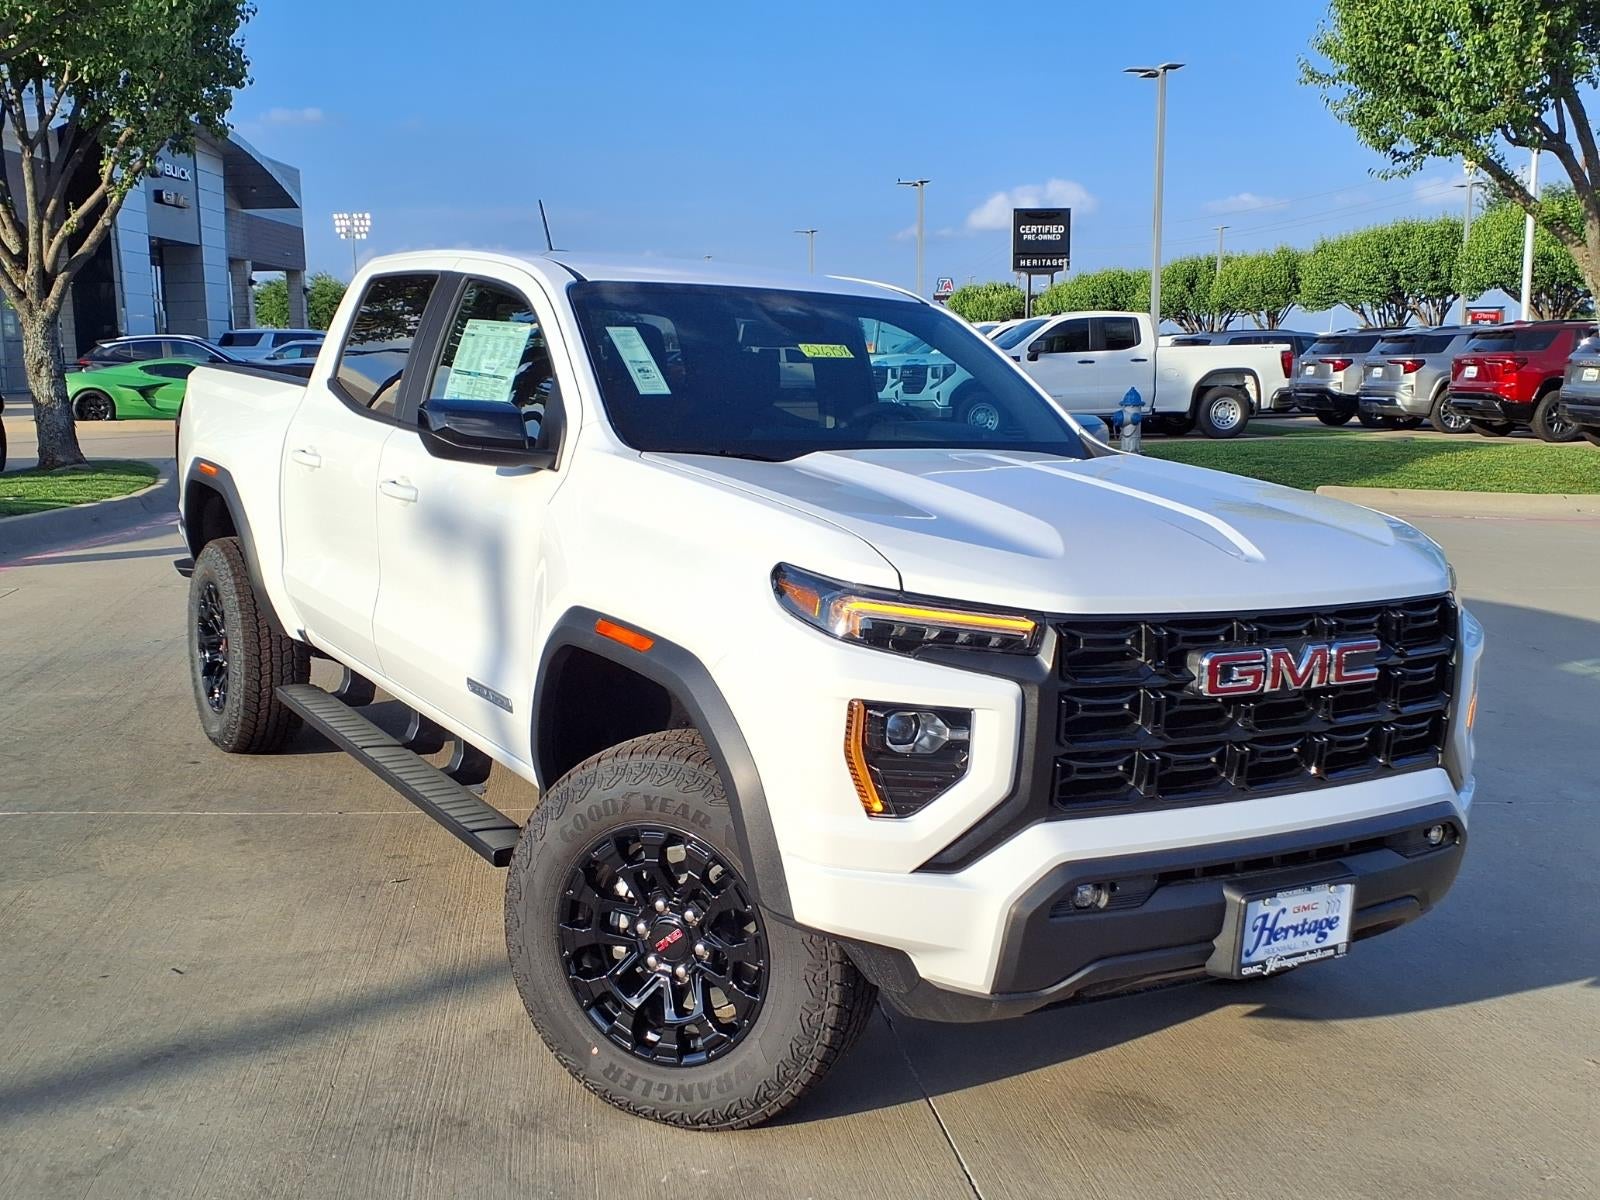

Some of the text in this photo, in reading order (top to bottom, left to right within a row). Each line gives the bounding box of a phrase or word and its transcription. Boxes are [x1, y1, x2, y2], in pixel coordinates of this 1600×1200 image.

[165, 163, 191, 181] BUICK
[1019, 225, 1065, 234] CERTIFIED
[1020, 259, 1064, 267] HERITAGE
[1199, 639, 1381, 696] GMC
[1292, 902, 1320, 914] GMC
[1244, 907, 1340, 958] Heritage
[1241, 964, 1263, 975] GMC
[601, 1060, 752, 1103] WRANGLER
